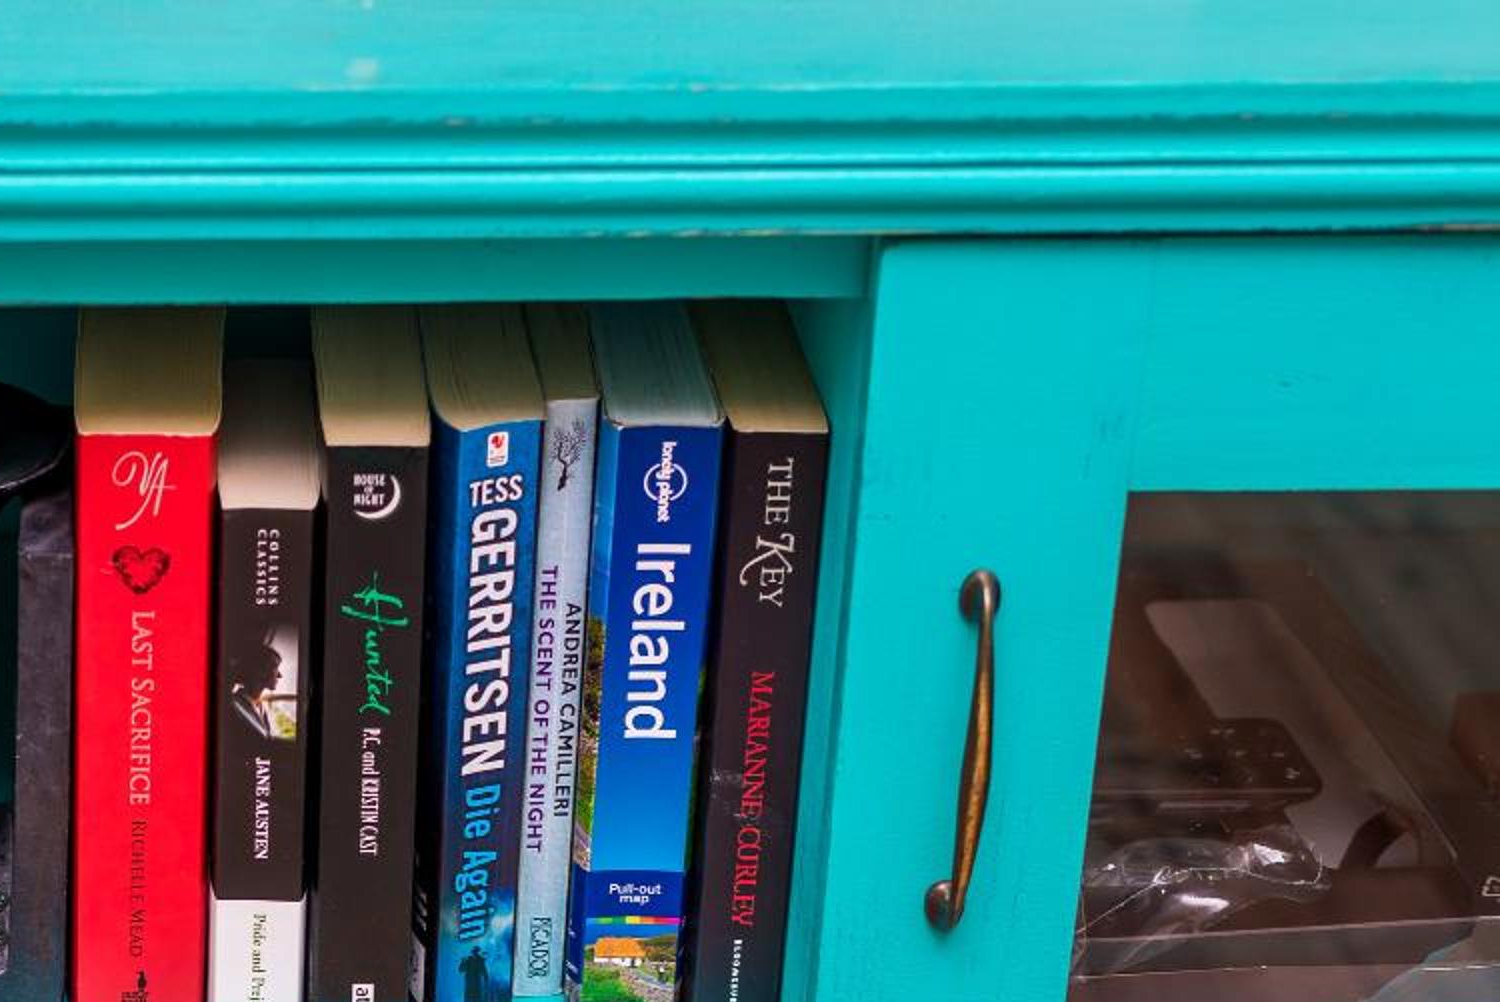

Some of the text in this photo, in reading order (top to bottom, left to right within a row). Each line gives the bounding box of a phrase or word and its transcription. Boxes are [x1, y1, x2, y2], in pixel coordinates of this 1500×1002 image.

[353, 473, 385, 487] HOUSE
[353, 493, 385, 507] NIGHT
[469, 475, 523, 507] TESS
[656, 440, 679, 523] lonely planet
[255, 528, 268, 606] CLASSICS
[267, 528, 280, 606] COLLINS
[739, 458, 795, 608] THE KEY
[541, 565, 558, 611] THE
[340, 572, 411, 716] Hunted
[461, 509, 518, 777] GERRITSEN
[537, 616, 556, 692] SCENT
[623, 543, 692, 740] Ireland
[128, 611, 155, 805] LAST SACRIFICE
[553, 603, 582, 817] ANDREA CAMILLERI
[361, 751, 377, 775] and
[530, 731, 548, 775] THE
[253, 757, 271, 859] JANE AUSTEN
[359, 775, 380, 822] KRISTIN
[526, 784, 546, 853] NIGHT
[730, 672, 774, 926] MARIANNE CURLEY
[358, 822, 378, 856] CAST
[454, 784, 501, 943] Die Again
[129, 820, 150, 957] RICHELLE MEAD
[609, 883, 661, 896] Pull-out
[619, 894, 649, 905] map
[251, 914, 268, 946] Pride
[251, 949, 265, 973] and
[529, 917, 551, 979] PICADOR
